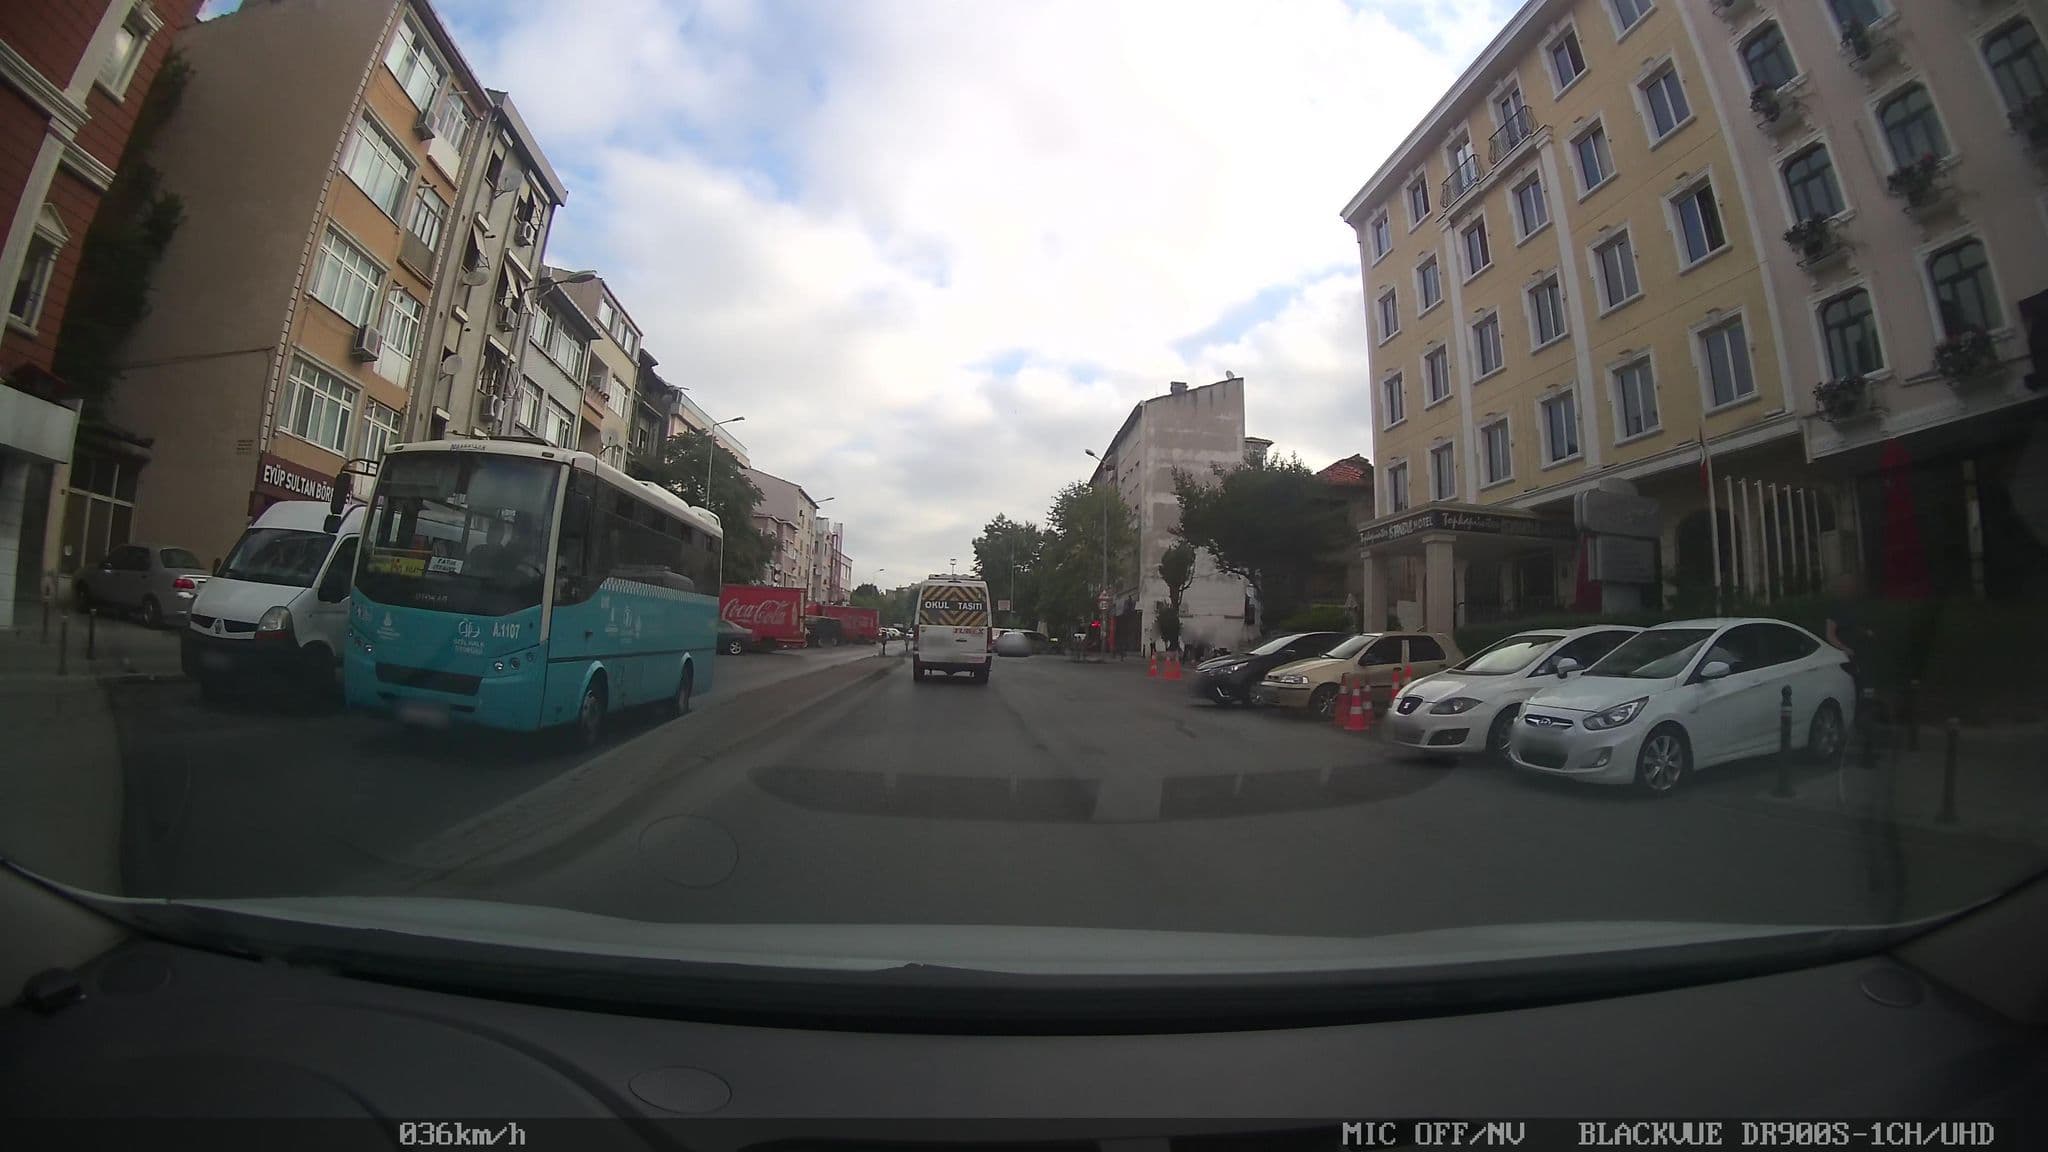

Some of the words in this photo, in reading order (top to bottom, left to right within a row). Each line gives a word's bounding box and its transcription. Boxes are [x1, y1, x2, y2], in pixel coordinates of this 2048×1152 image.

[264, 463, 286, 488] EYÜP
[285, 473, 316, 499] SULTAN
[924, 601, 949, 609] OKUL
